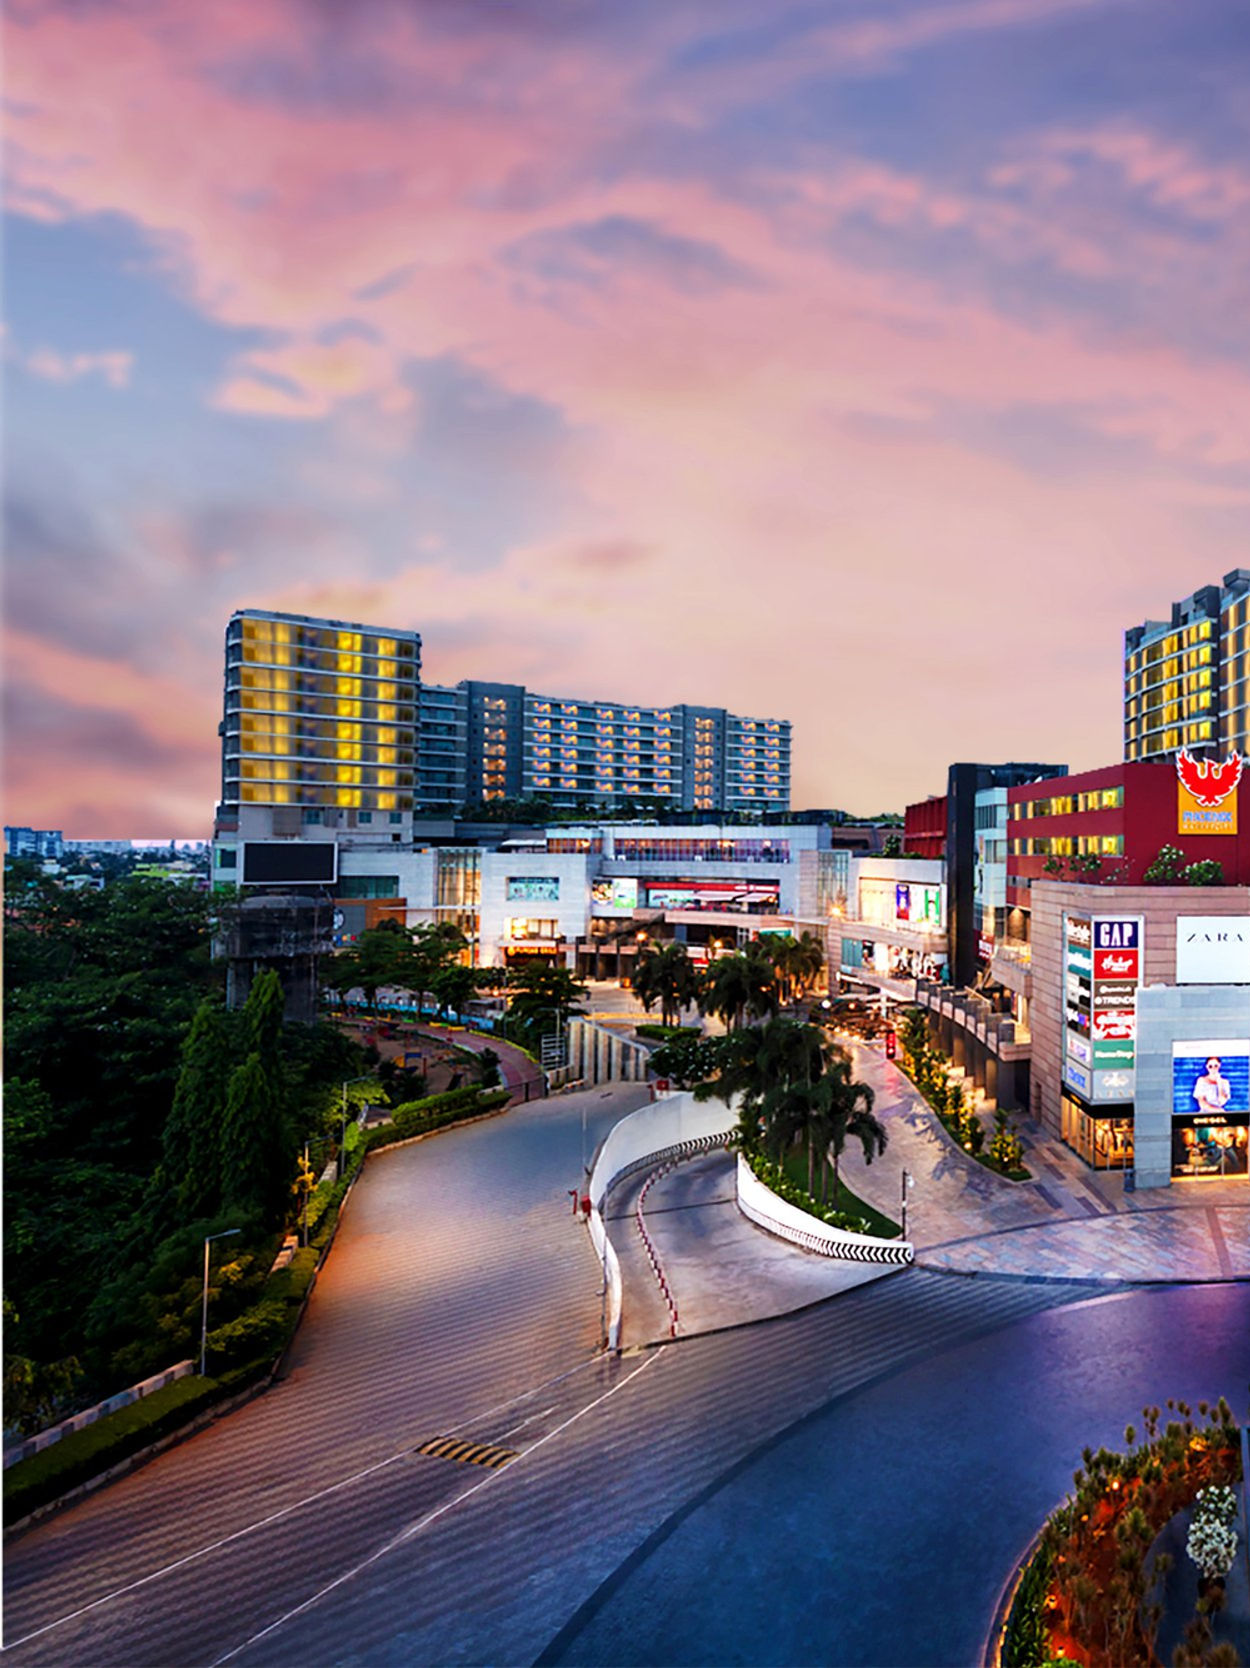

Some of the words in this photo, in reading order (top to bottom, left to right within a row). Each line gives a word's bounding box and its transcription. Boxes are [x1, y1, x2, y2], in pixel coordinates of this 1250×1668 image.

[1183, 811, 1232, 822] PHOENIX
[1100, 923, 1133, 947] GAP
[1186, 932, 1244, 942] ZARA
